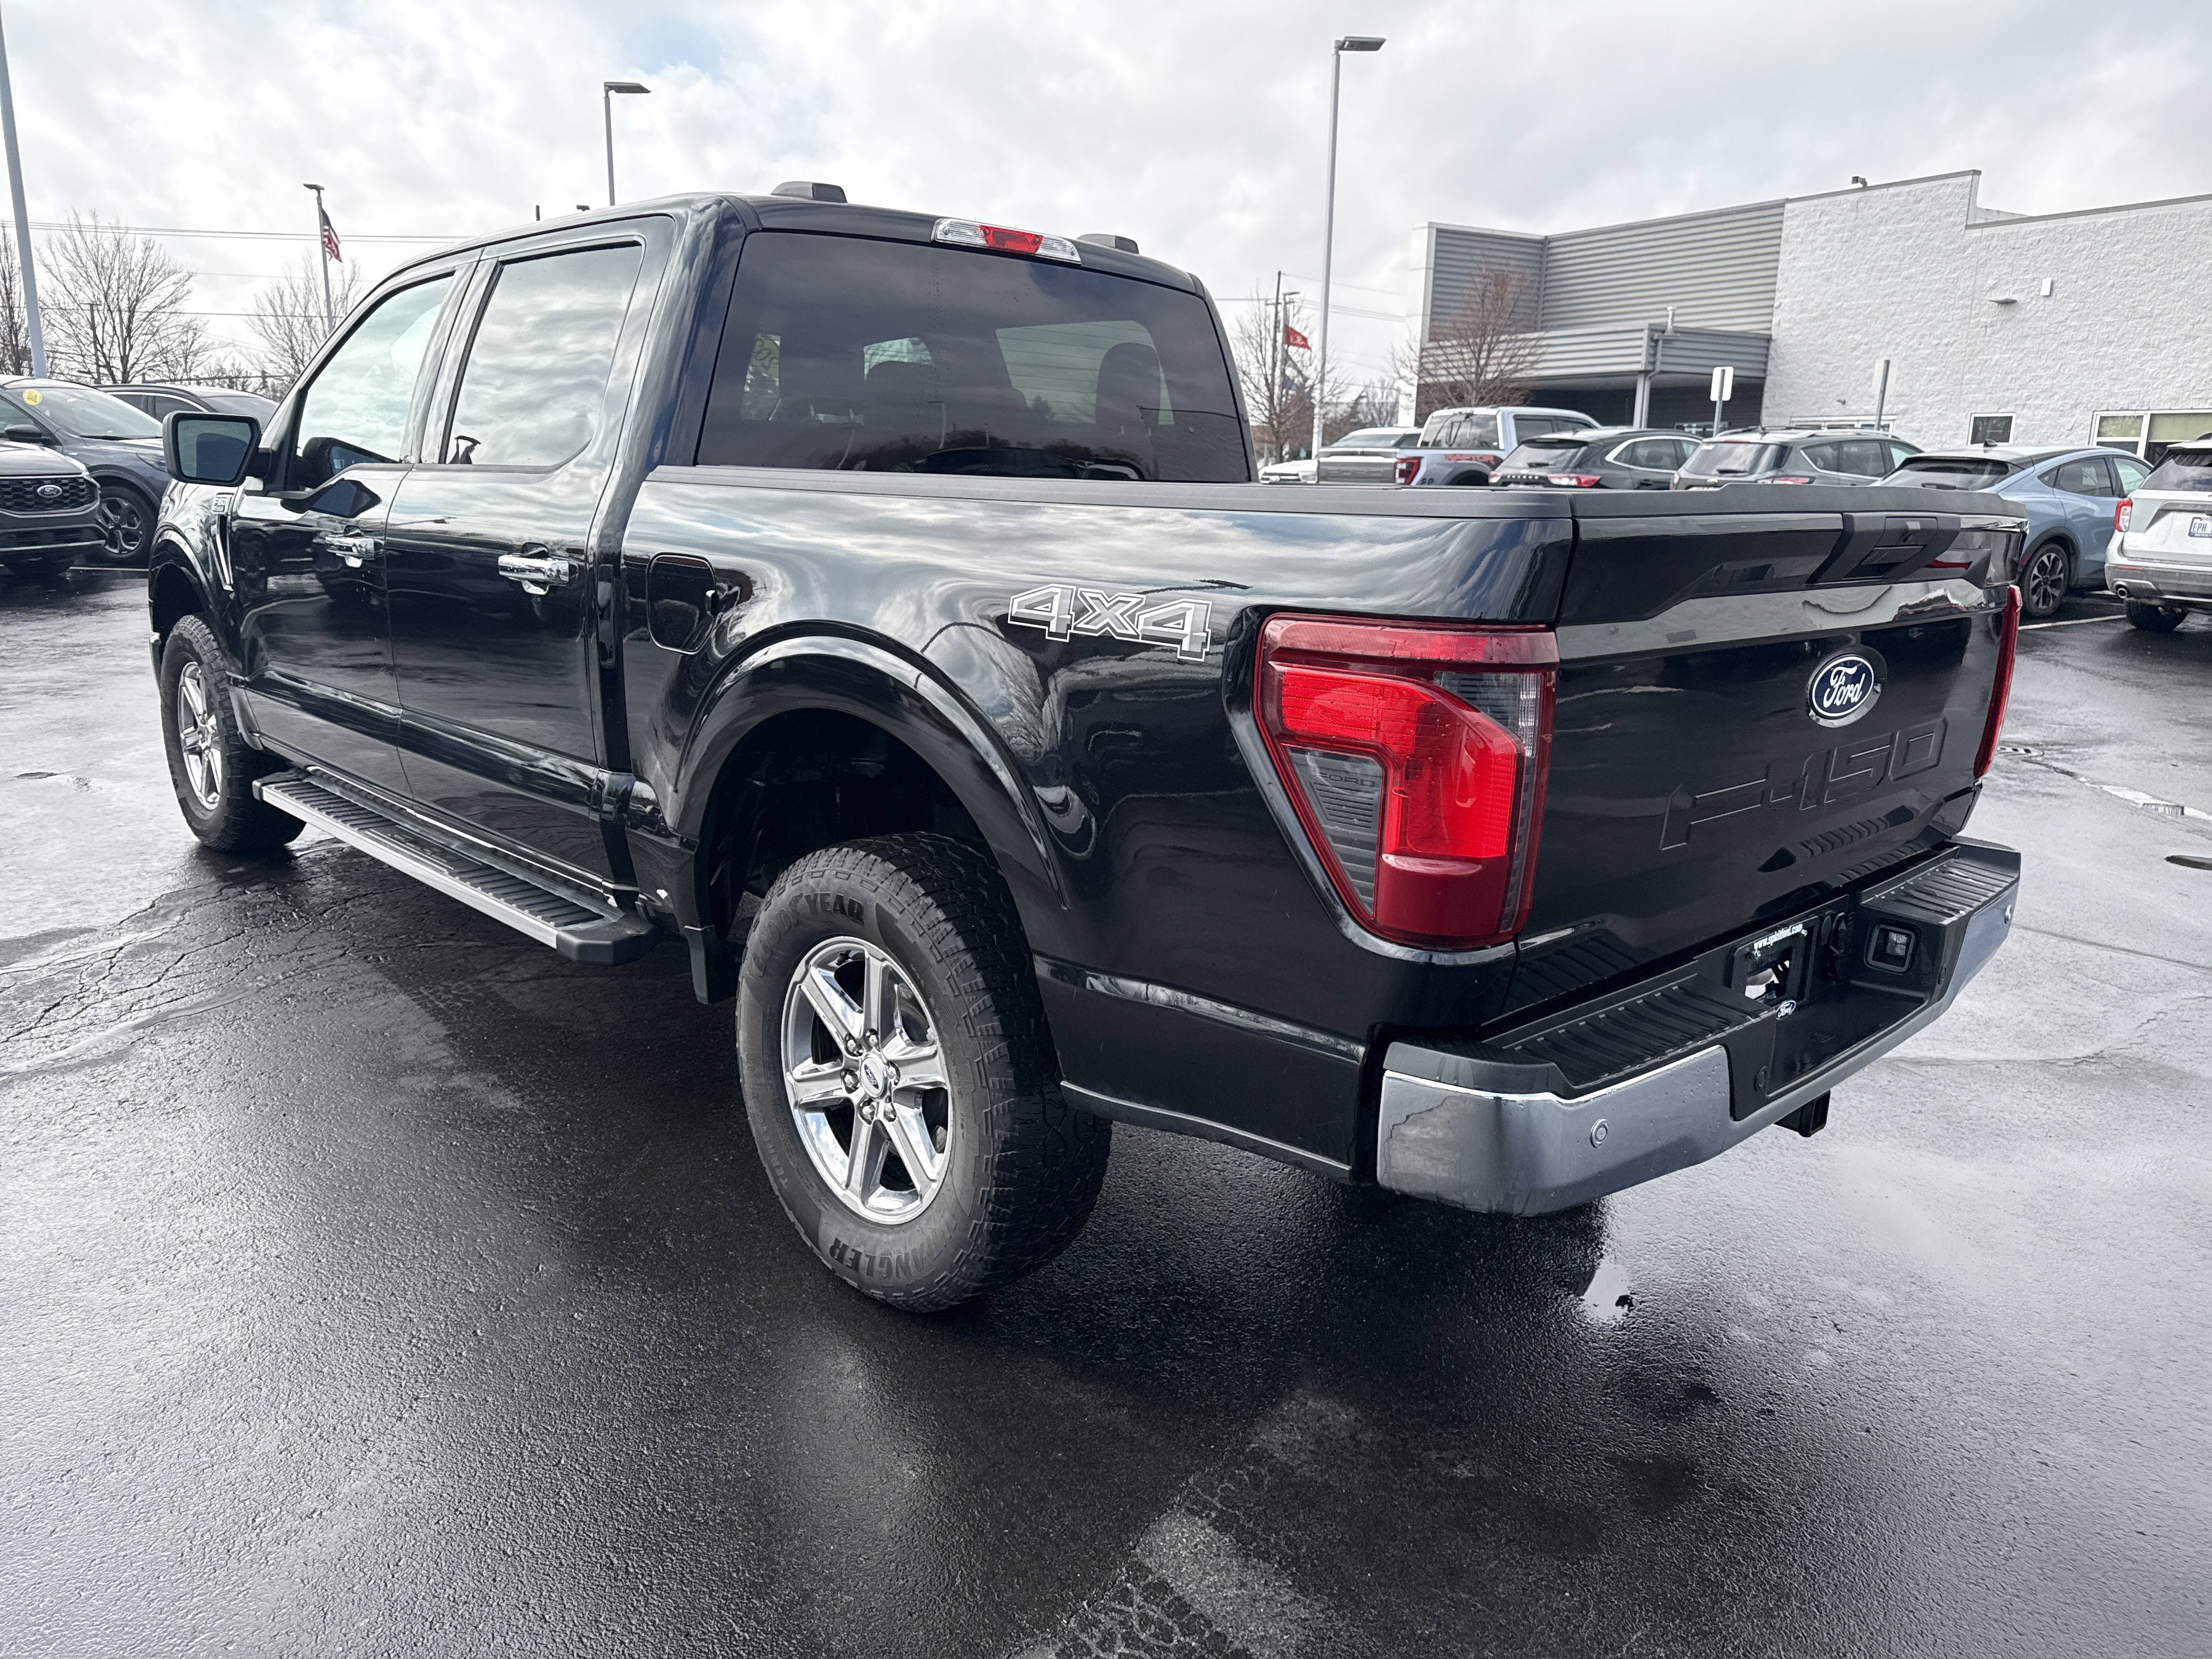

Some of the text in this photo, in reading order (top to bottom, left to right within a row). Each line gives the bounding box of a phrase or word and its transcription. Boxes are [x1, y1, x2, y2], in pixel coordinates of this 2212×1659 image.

[2193, 522, 2208, 533] EPH
[1822, 665, 1866, 708] Ford
[1319, 771, 1375, 787] FORD
[1660, 717, 1948, 851] F-150
[752, 891, 865, 979] GOODYEAR
[829, 1210, 958, 1279] WRANGLER
